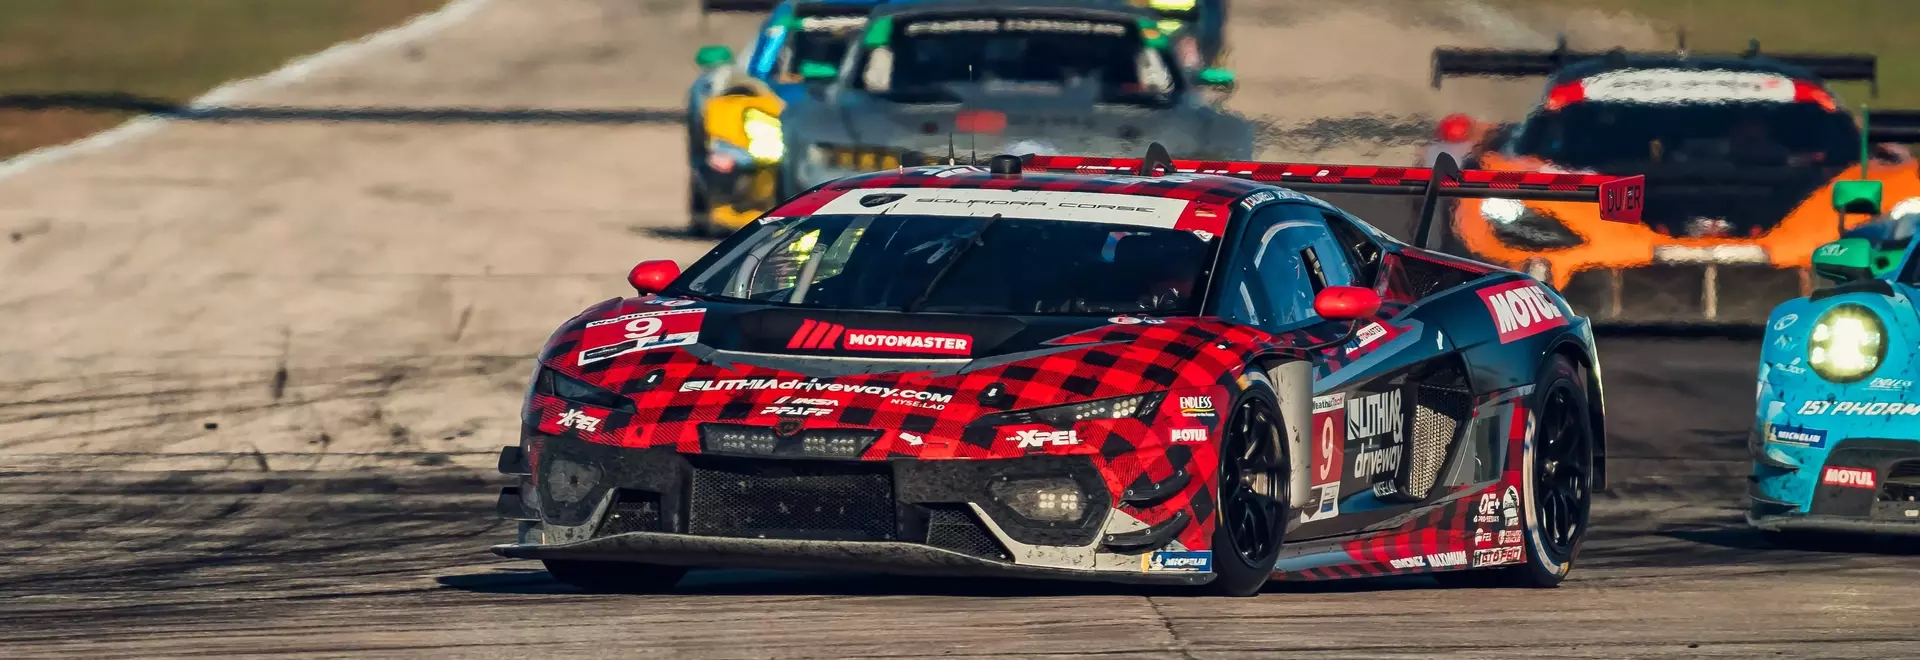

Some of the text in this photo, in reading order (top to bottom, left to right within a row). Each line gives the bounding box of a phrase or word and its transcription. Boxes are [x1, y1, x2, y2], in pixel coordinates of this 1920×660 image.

[915, 197, 1155, 213] SQUADRA CORSE
[1488, 285, 1562, 334] MOTUL
[624, 317, 662, 339] 9
[848, 333, 967, 350] MOTOMASTER
[760, 406, 834, 416] PFAFF
[890, 398, 945, 411] NYSE:LAD
[1179, 396, 1213, 409] ENDLESS
[556, 409, 601, 432] XPEL
[1016, 429, 1080, 448] XPEL
[1171, 429, 1207, 442] MOTUL
[1778, 430, 1821, 443] MICHELIN
[1320, 416, 1334, 480] 9
[1354, 438, 1403, 483] driveway
[1824, 468, 1874, 486] MOTUL
[1164, 558, 1208, 566] MICHELIN
